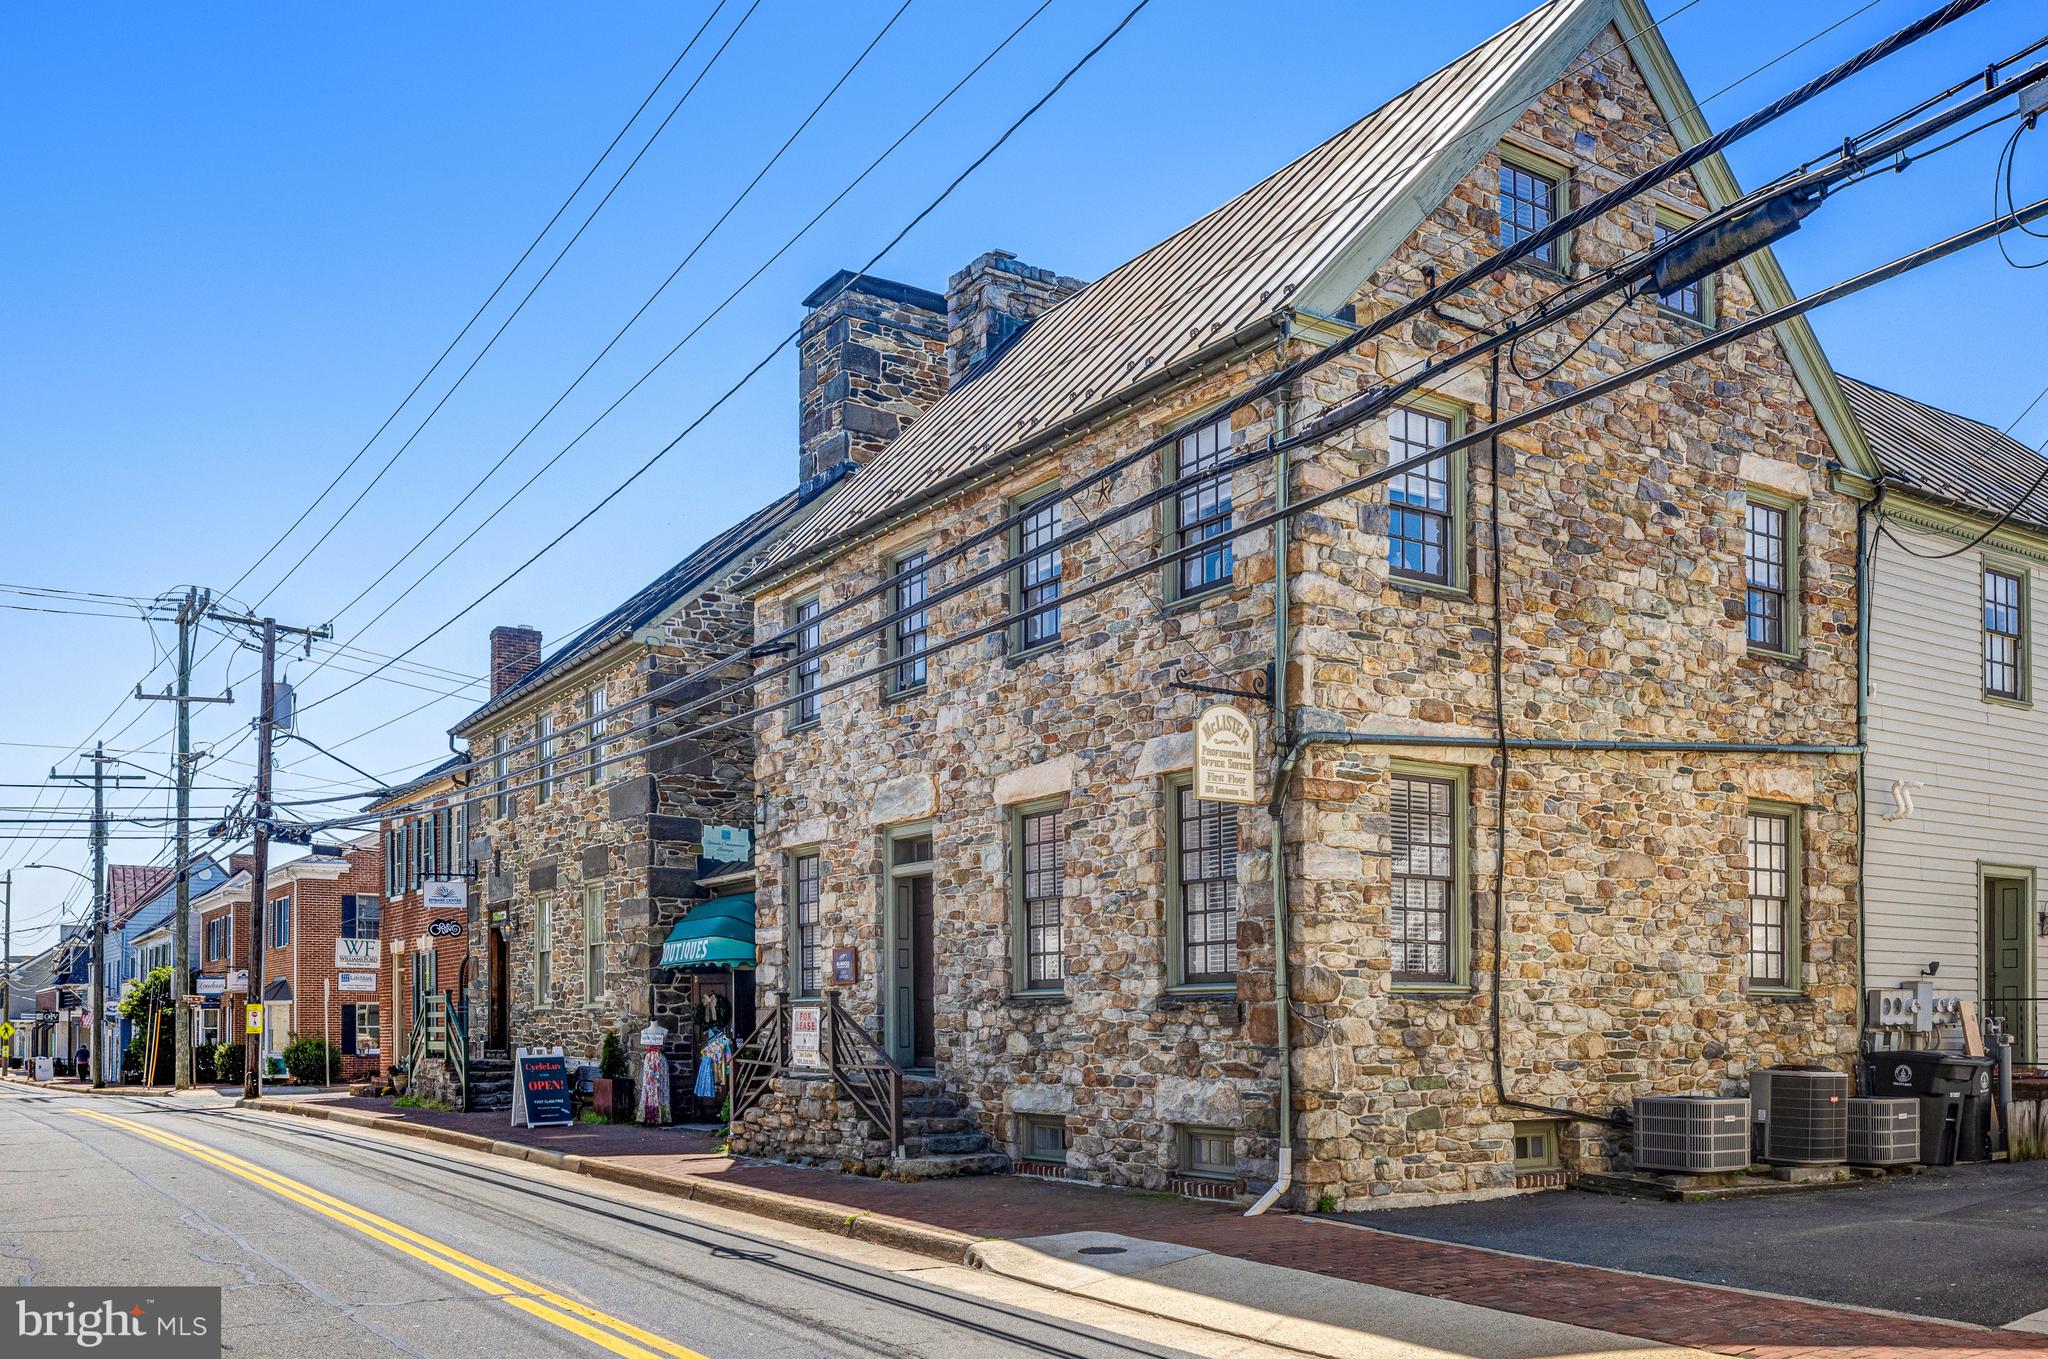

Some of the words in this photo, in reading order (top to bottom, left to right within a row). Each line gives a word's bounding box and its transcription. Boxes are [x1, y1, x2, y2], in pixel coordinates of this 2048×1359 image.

[1202, 714, 1249, 746] McLISTER
[1202, 745, 1251, 760] PROFESSIONAL
[1201, 757, 1225, 768] OFFICE
[1228, 759, 1252, 771] SUITES
[1207, 772, 1224, 782] First
[1228, 774, 1246, 785] Floor
[343, 940, 375, 956] WF
[800, 1012, 812, 1020] FOR
[795, 1021, 816, 1031] LEASE
[528, 1080, 564, 1091] OPEN!
